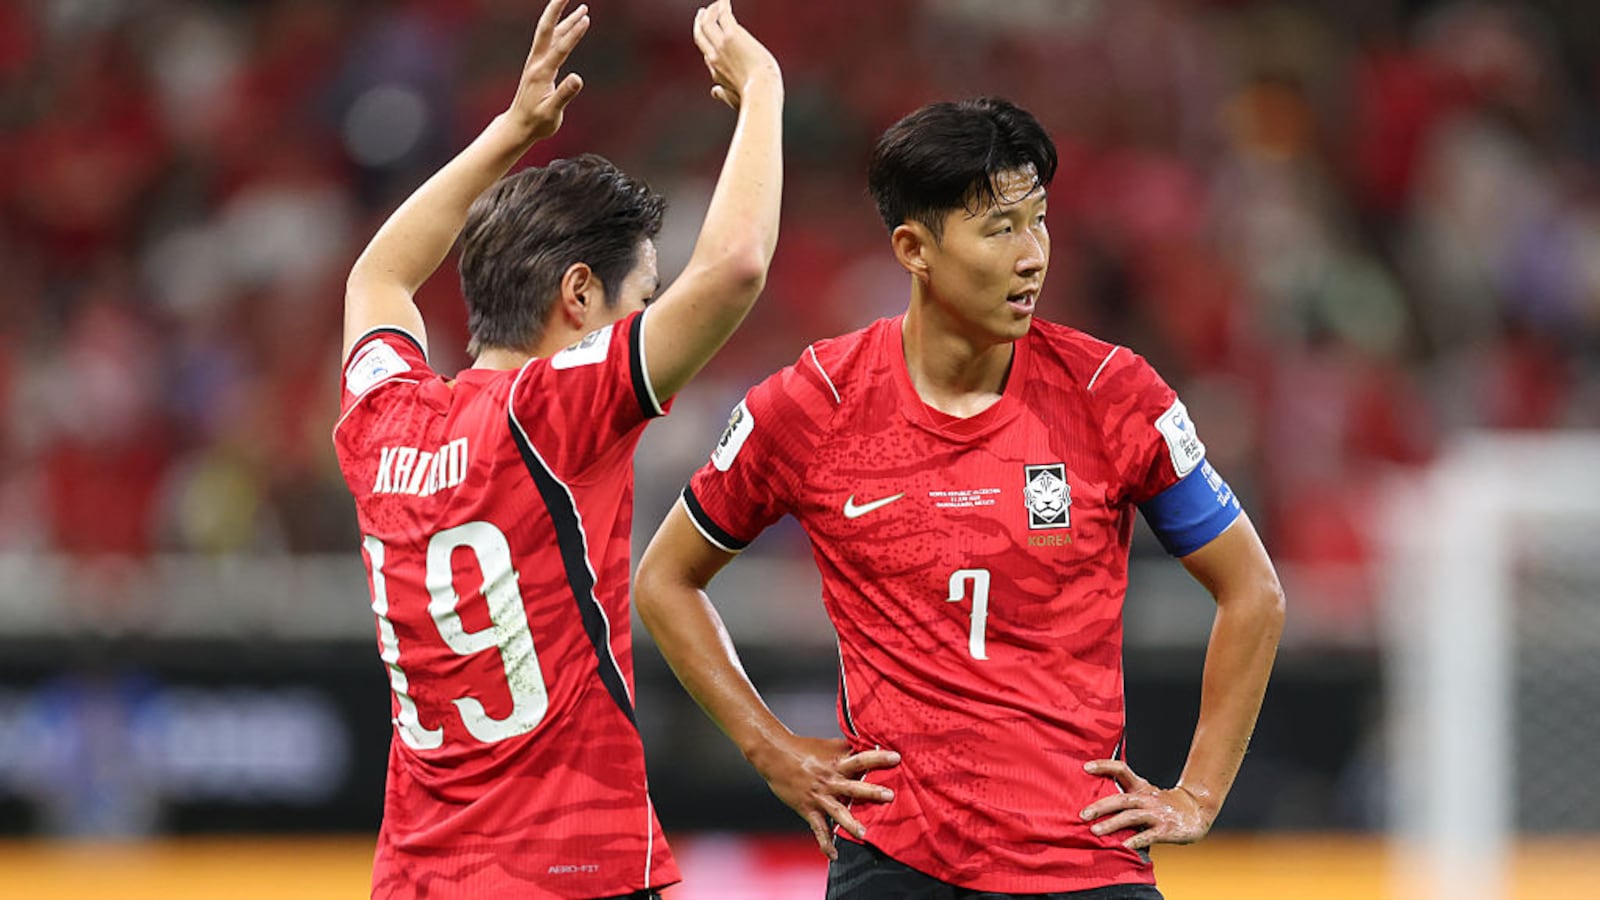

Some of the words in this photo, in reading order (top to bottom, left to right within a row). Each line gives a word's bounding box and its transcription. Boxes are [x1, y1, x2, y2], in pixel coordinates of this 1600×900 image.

[1027, 533, 1073, 547] KOREA
[362, 520, 549, 750] 19
[945, 568, 990, 660] 7
